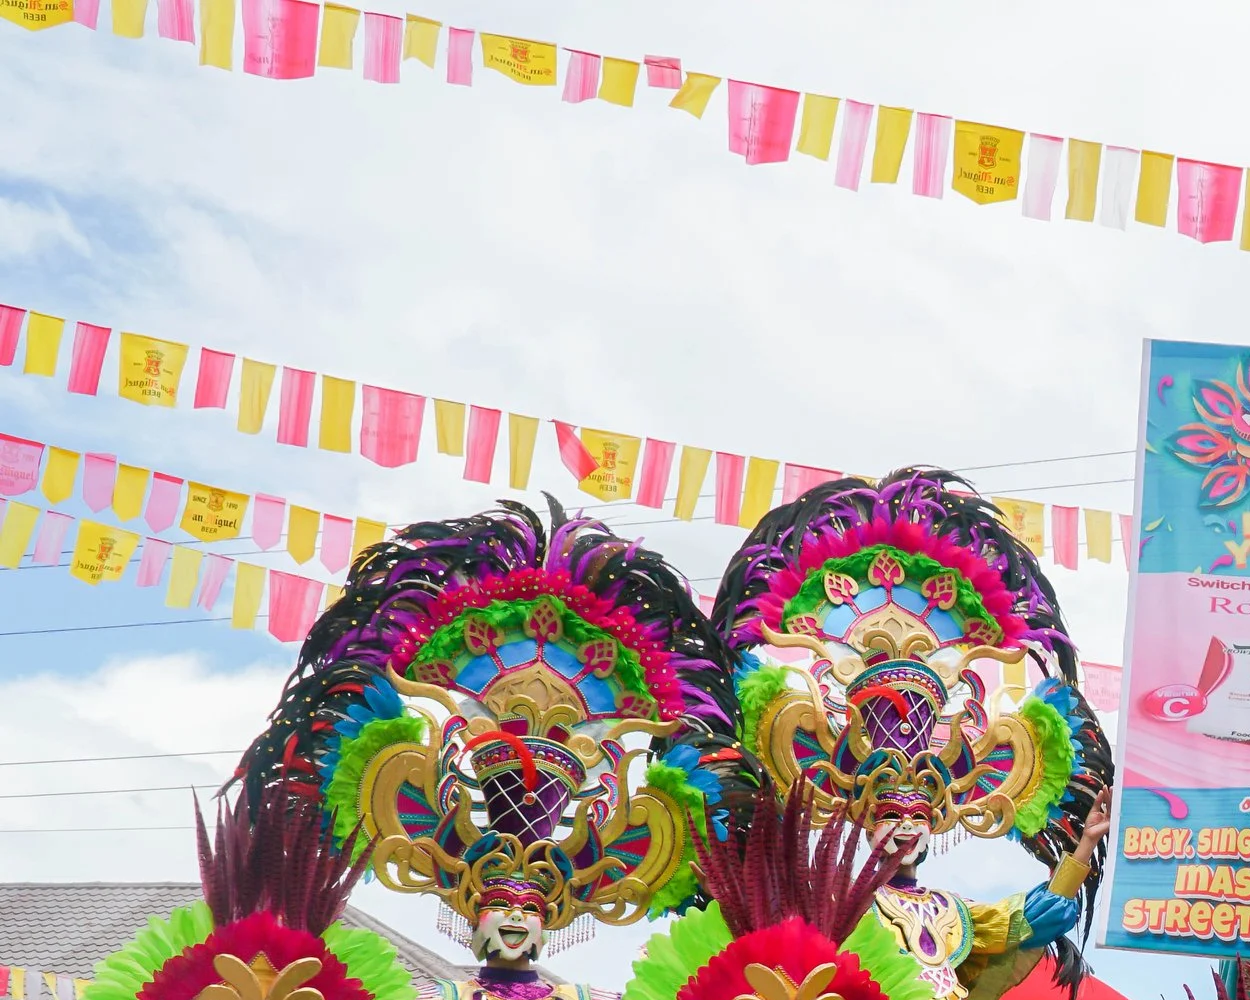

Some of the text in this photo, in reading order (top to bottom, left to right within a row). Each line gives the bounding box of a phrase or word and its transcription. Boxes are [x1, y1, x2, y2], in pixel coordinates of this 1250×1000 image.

[192, 495, 207, 504] SINCE
[1162, 697, 1190, 718] C
[1124, 827, 1194, 858] BRGY.
